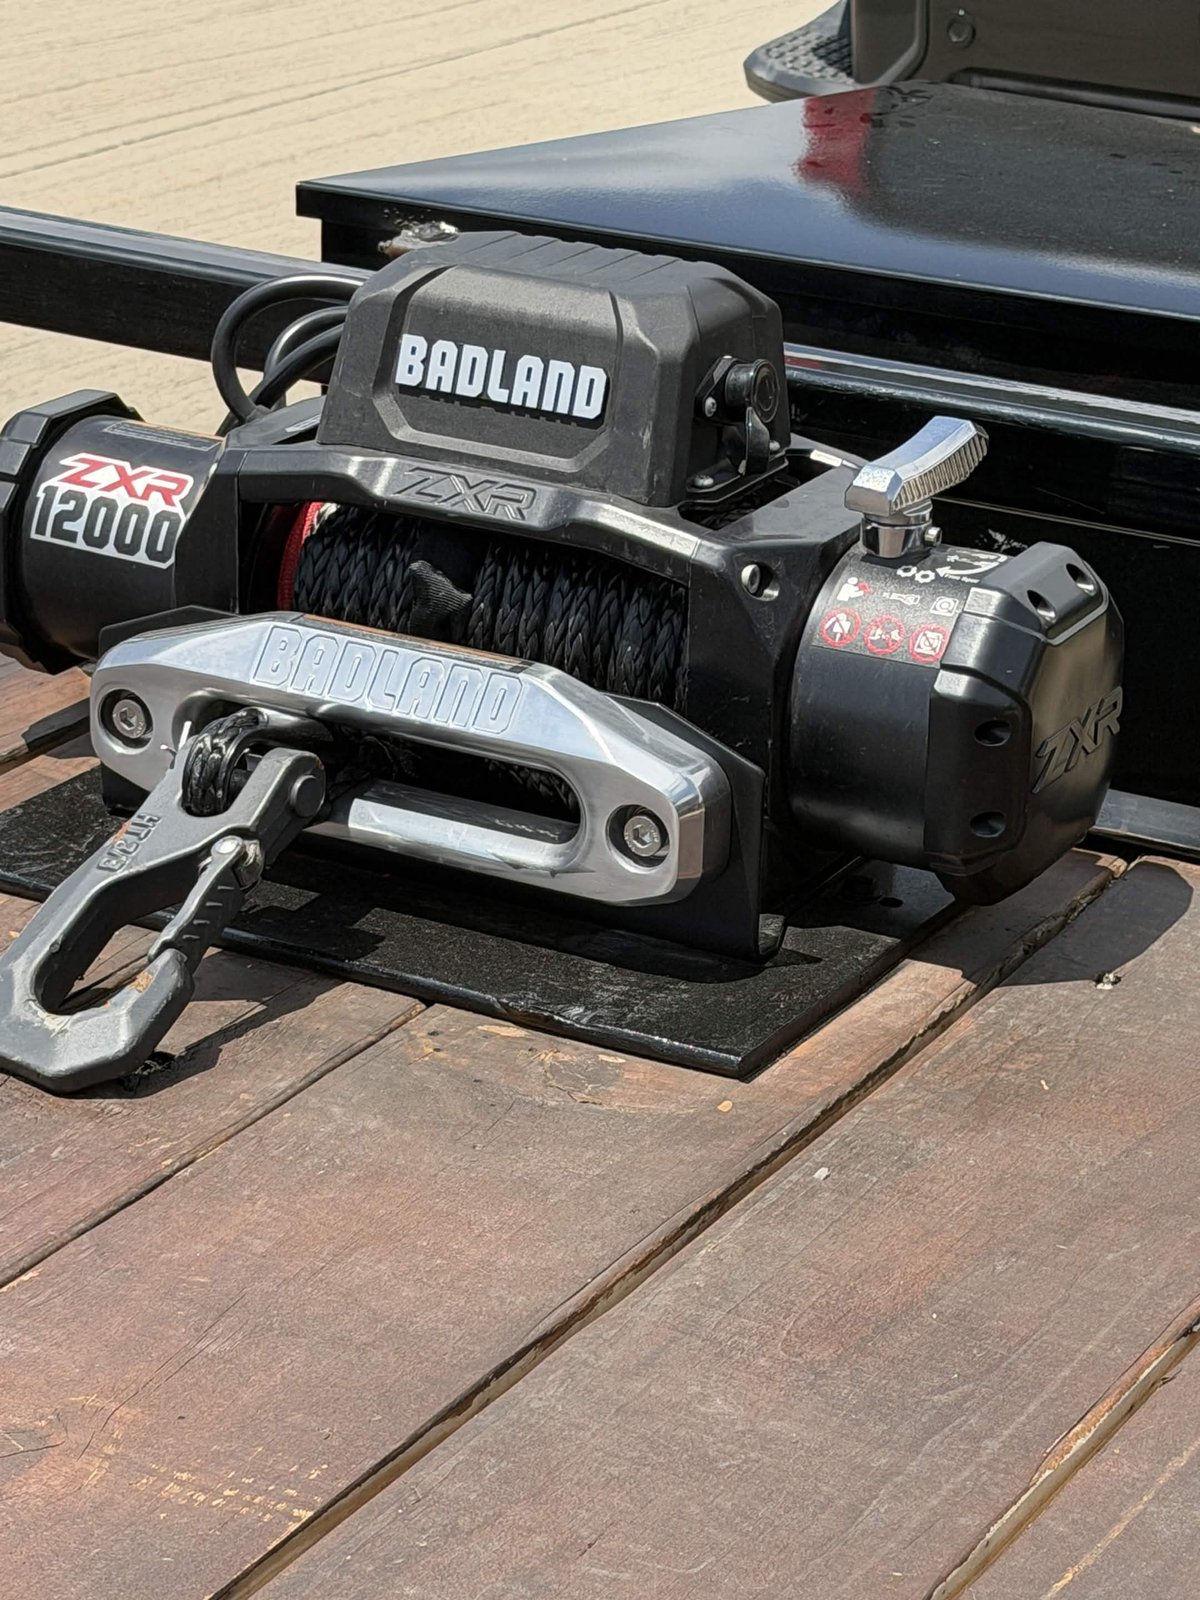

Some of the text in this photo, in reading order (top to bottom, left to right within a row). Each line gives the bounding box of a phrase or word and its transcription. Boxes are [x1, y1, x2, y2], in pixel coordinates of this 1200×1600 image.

[395, 334, 608, 420] BADLAND
[54, 455, 190, 507] ZXR
[391, 466, 537, 520] ZXR
[35, 485, 183, 564] 12000
[253, 626, 523, 734] BADLAND
[1031, 686, 1123, 794] ZXR
